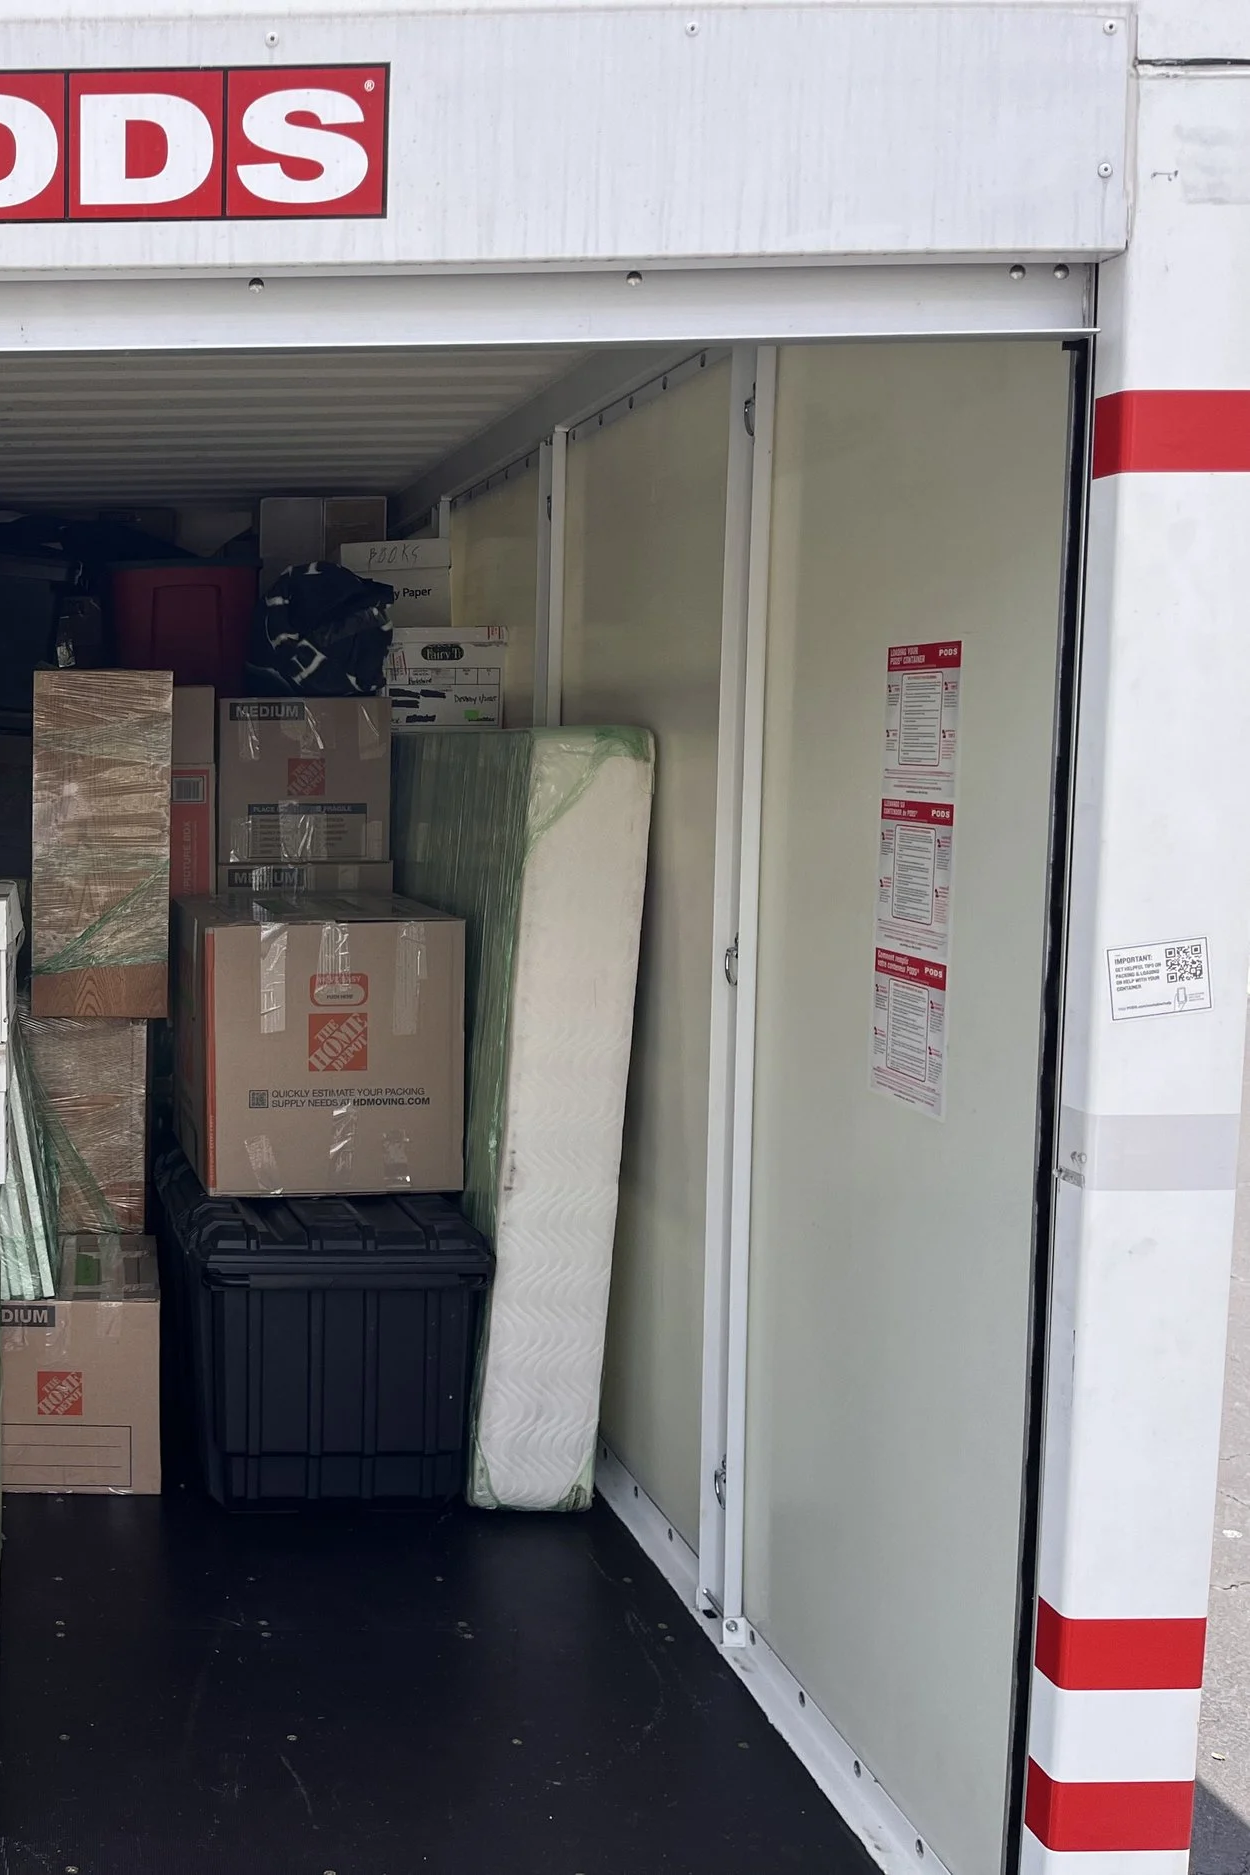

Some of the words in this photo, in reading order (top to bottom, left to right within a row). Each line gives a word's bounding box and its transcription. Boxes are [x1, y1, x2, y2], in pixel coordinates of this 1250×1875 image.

[402, 587, 433, 599] Paper
[939, 648, 958, 656] PODS
[236, 705, 299, 717] MEDIUM
[931, 810, 950, 818] PODS
[234, 872, 297, 884] MEIUM
[1114, 954, 1153, 965] IMPORTANT:
[924, 966, 943, 978] PODS
[315, 1019, 339, 1042] THE
[308, 1012, 368, 1071] HOME
[330, 1033, 368, 1071] DEPOT
[271, 1089, 310, 1099] QUICKLY
[312, 1088, 355, 1098] ESTIMATE
[357, 1088, 383, 1096] YOUR
[385, 1087, 425, 1096] PACKING
[271, 1099, 306, 1108] SUPPLY
[308, 1098, 338, 1107] NEEDS
[339, 1098, 349, 1107] AT
[353, 1097, 430, 1107] HDMOVING.COM
[1, 1308, 48, 1323] DIUM
[38, 1371, 83, 1415] HOME
